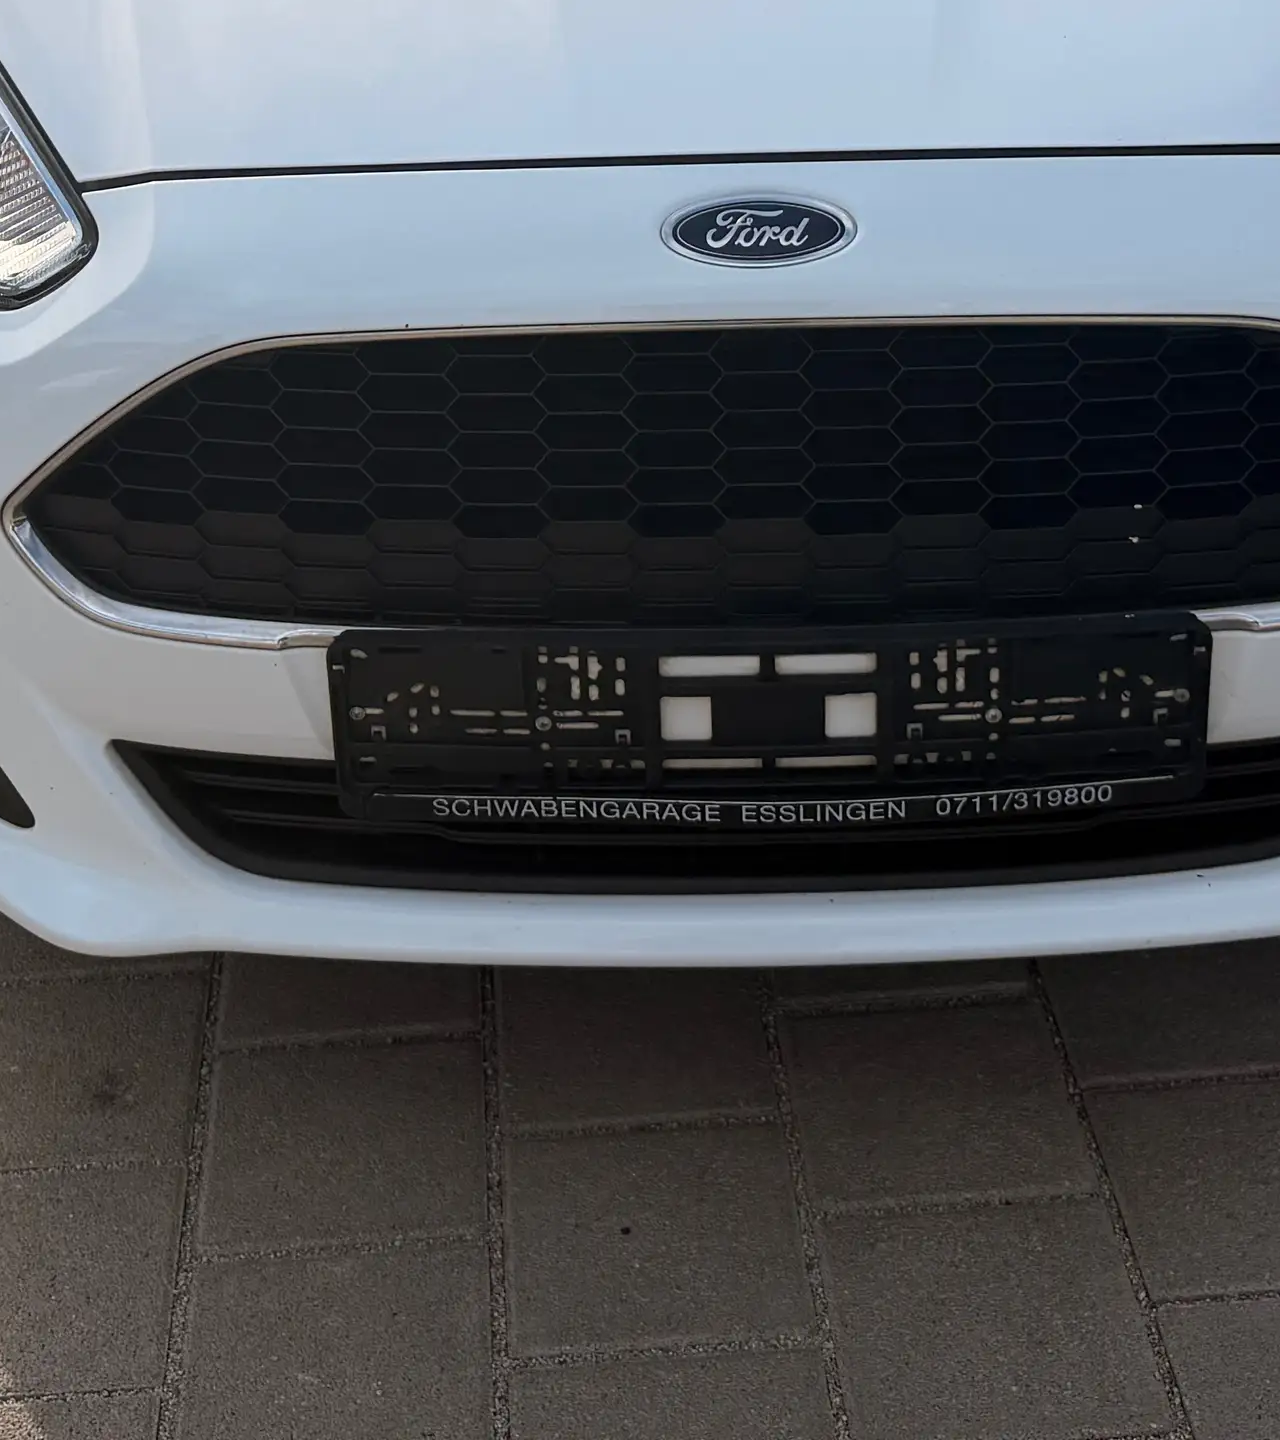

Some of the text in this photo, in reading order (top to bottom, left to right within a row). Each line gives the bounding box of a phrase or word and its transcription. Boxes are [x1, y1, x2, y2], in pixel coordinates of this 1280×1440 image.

[706, 209, 810, 249] Ford
[432, 784, 1113, 822] SCHWABENGARAGE ESSLINGEN 0711/319800
